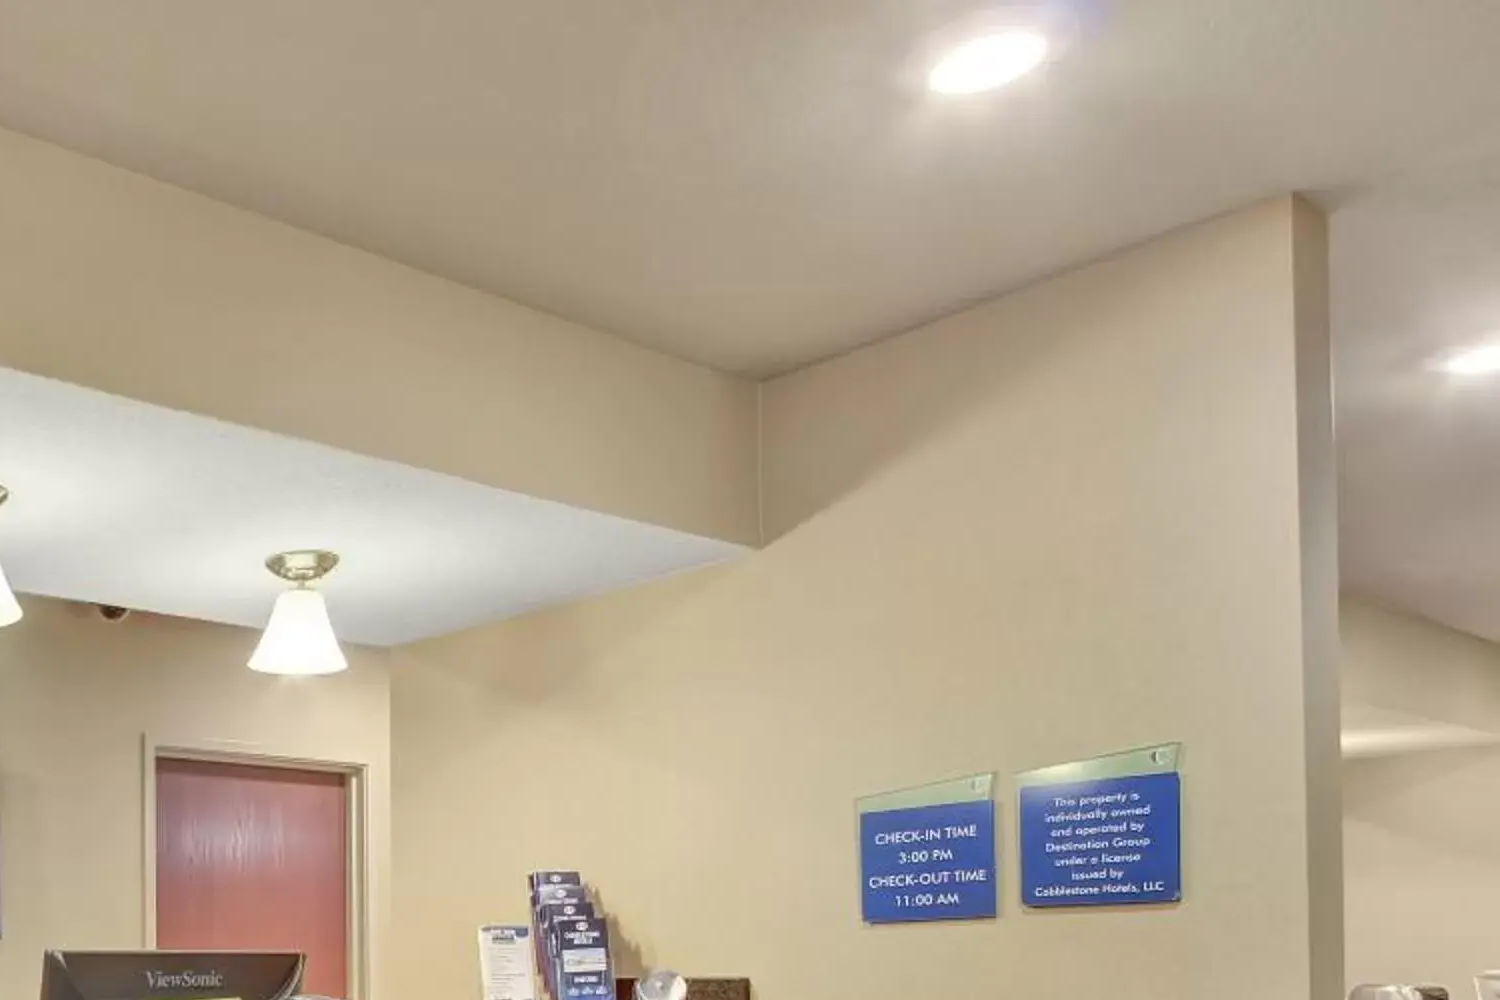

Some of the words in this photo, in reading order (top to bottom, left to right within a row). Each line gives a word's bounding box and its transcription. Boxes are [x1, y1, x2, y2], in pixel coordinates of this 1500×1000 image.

[1053, 797, 1077, 808] This
[1079, 793, 1127, 807] property
[1044, 808, 1108, 823] individually
[1111, 804, 1151, 817] owned
[875, 827, 941, 846] CHECK-IN
[944, 823, 977, 840] TIME
[1050, 826, 1073, 838] and
[1075, 821, 1127, 836] operated
[1130, 820, 1145, 832] by
[1045, 838, 1109, 853] Destination
[1112, 836, 1151, 848] Group
[898, 850, 929, 865] 3:00
[932, 848, 954, 861] PM
[1054, 855, 1087, 867] under
[1101, 852, 1141, 865] license
[869, 871, 950, 889] CHECK-OUT
[954, 868, 987, 883] TIME
[1071, 867, 1107, 881] issued
[1109, 867, 1124, 880] by
[1035, 885, 1099, 897] Cobblestone
[1143, 880, 1165, 892] LLC
[895, 892, 933, 907] 11:00
[937, 891, 960, 905] AM
[146, 970, 224, 989] ViewSonic
